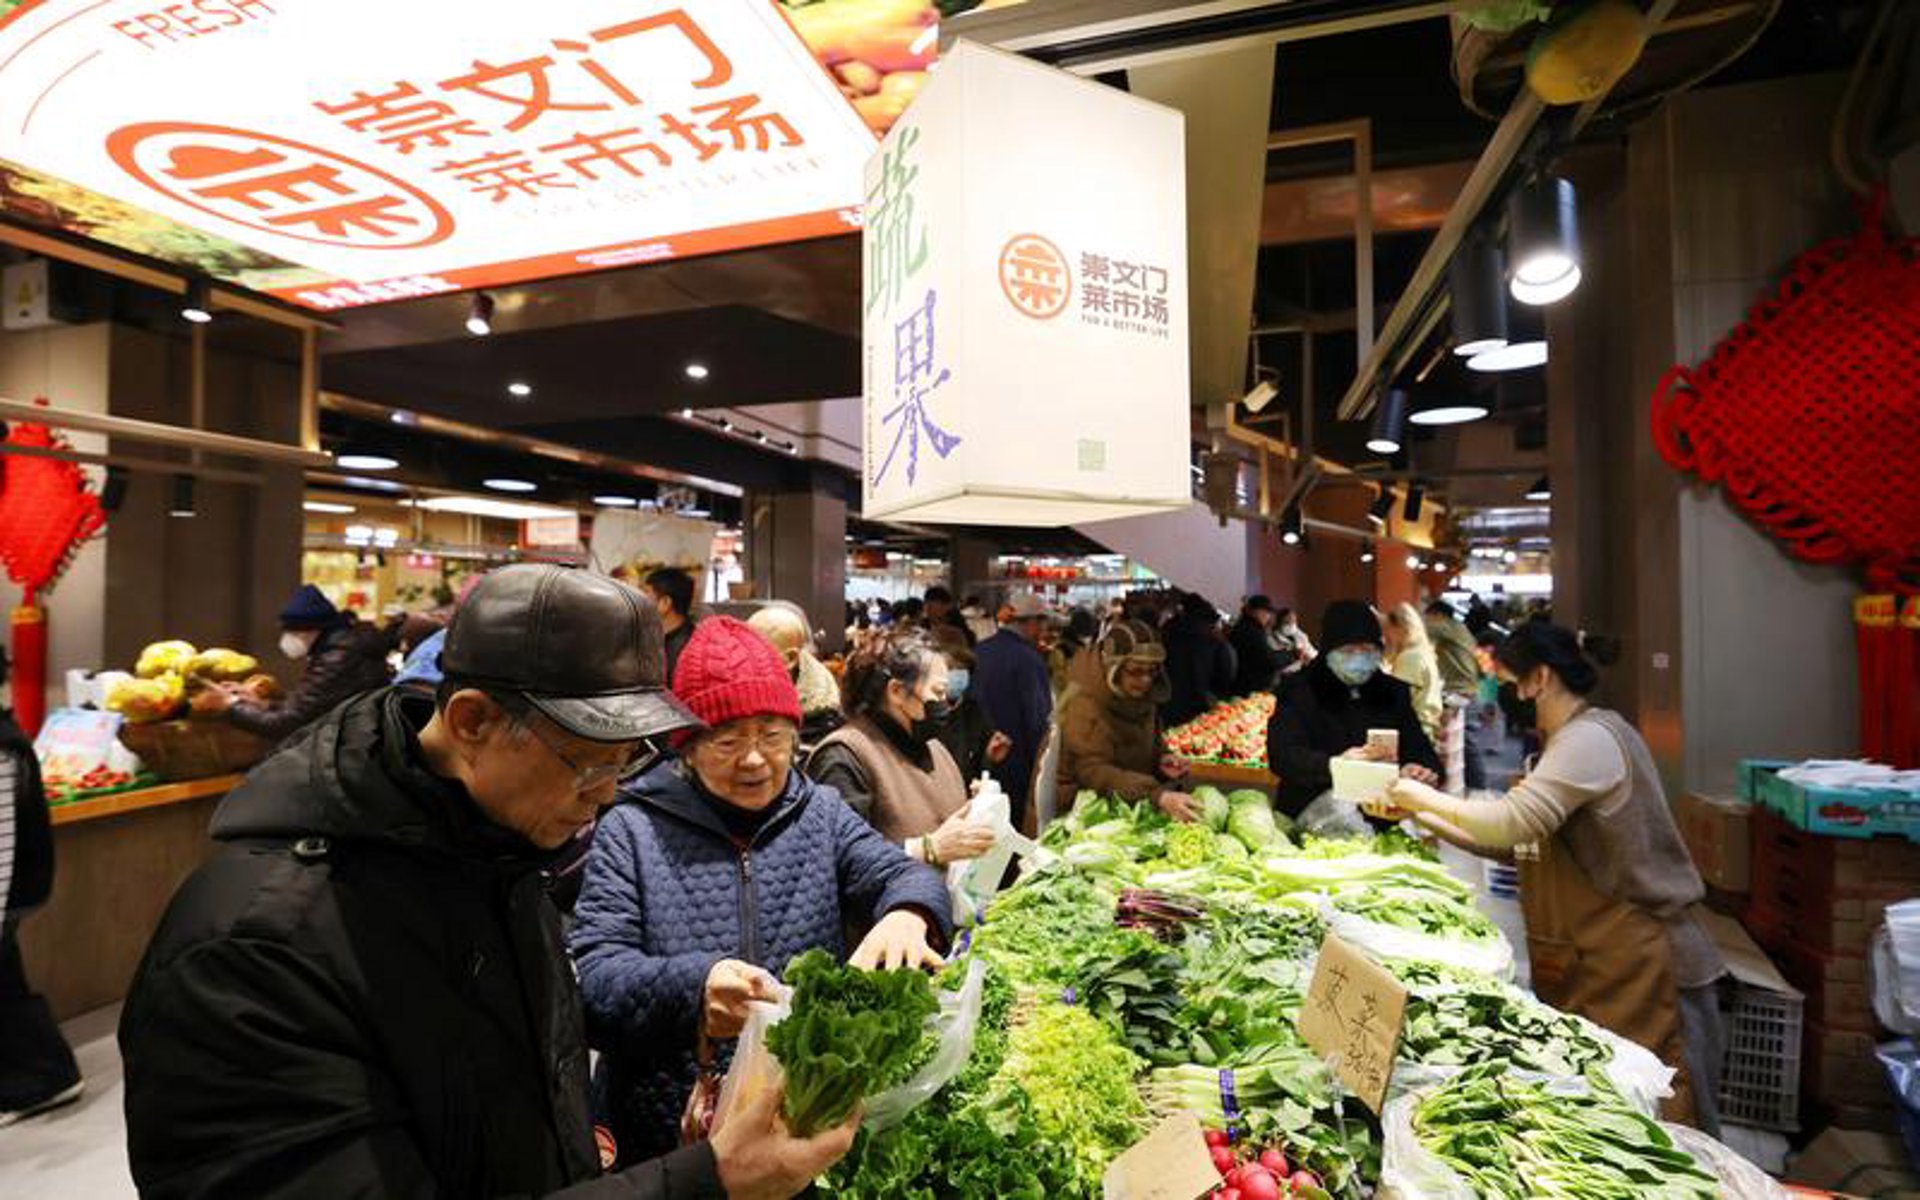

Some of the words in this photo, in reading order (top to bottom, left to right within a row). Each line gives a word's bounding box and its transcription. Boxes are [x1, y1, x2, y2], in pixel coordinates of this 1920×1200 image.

[313, 8, 733, 155] 崇文门
[431, 93, 806, 204] 菜市场
[1080, 250, 1169, 294] 崇文门
[1080, 283, 1169, 325] 菜市场
